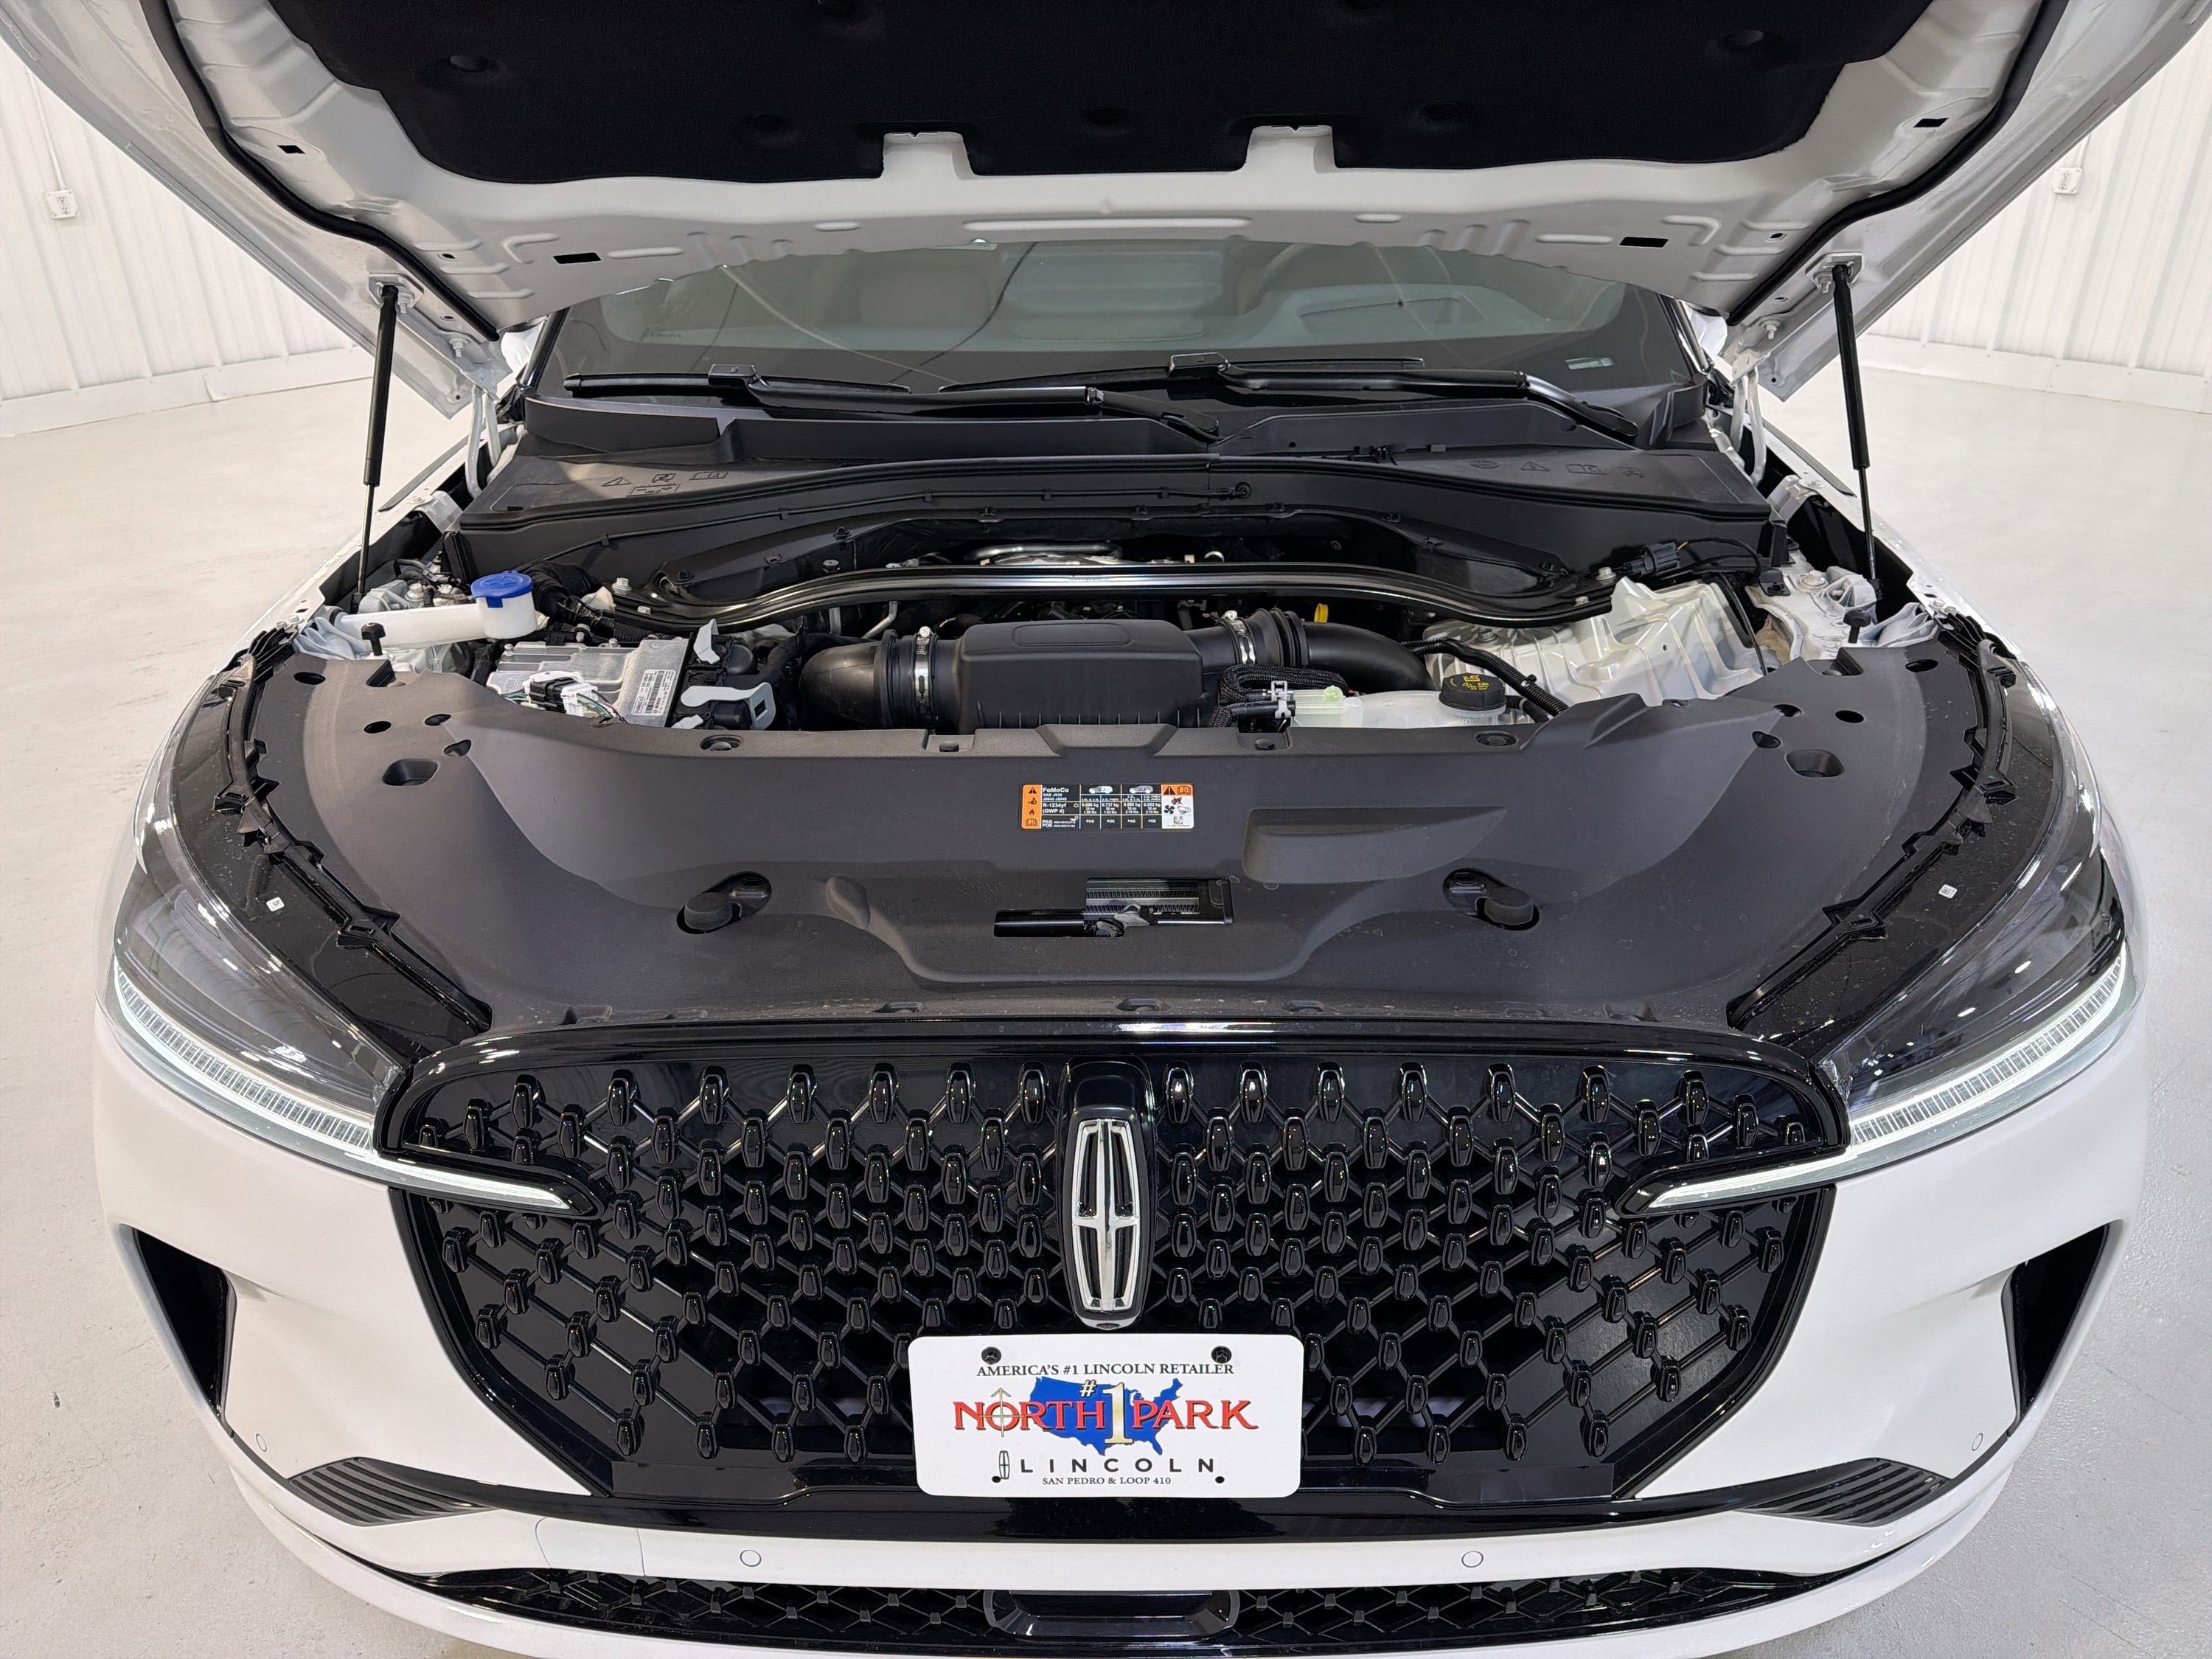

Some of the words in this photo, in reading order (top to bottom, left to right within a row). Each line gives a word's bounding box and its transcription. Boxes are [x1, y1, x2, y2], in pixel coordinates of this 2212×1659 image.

[976, 1364, 1059, 1377] AMERICA'S
[1063, 1365, 1077, 1375] #1
[1084, 1363, 1155, 1375] LINCOLN
[1160, 1363, 1234, 1374] RETAILER
[953, 1401, 1105, 1430] NORTH
[1131, 1399, 1259, 1430] PARK
[1020, 1458, 1214, 1473] LINCOLN
[1042, 1477, 1065, 1485] SAN
[1067, 1477, 1105, 1485] PEDRO
